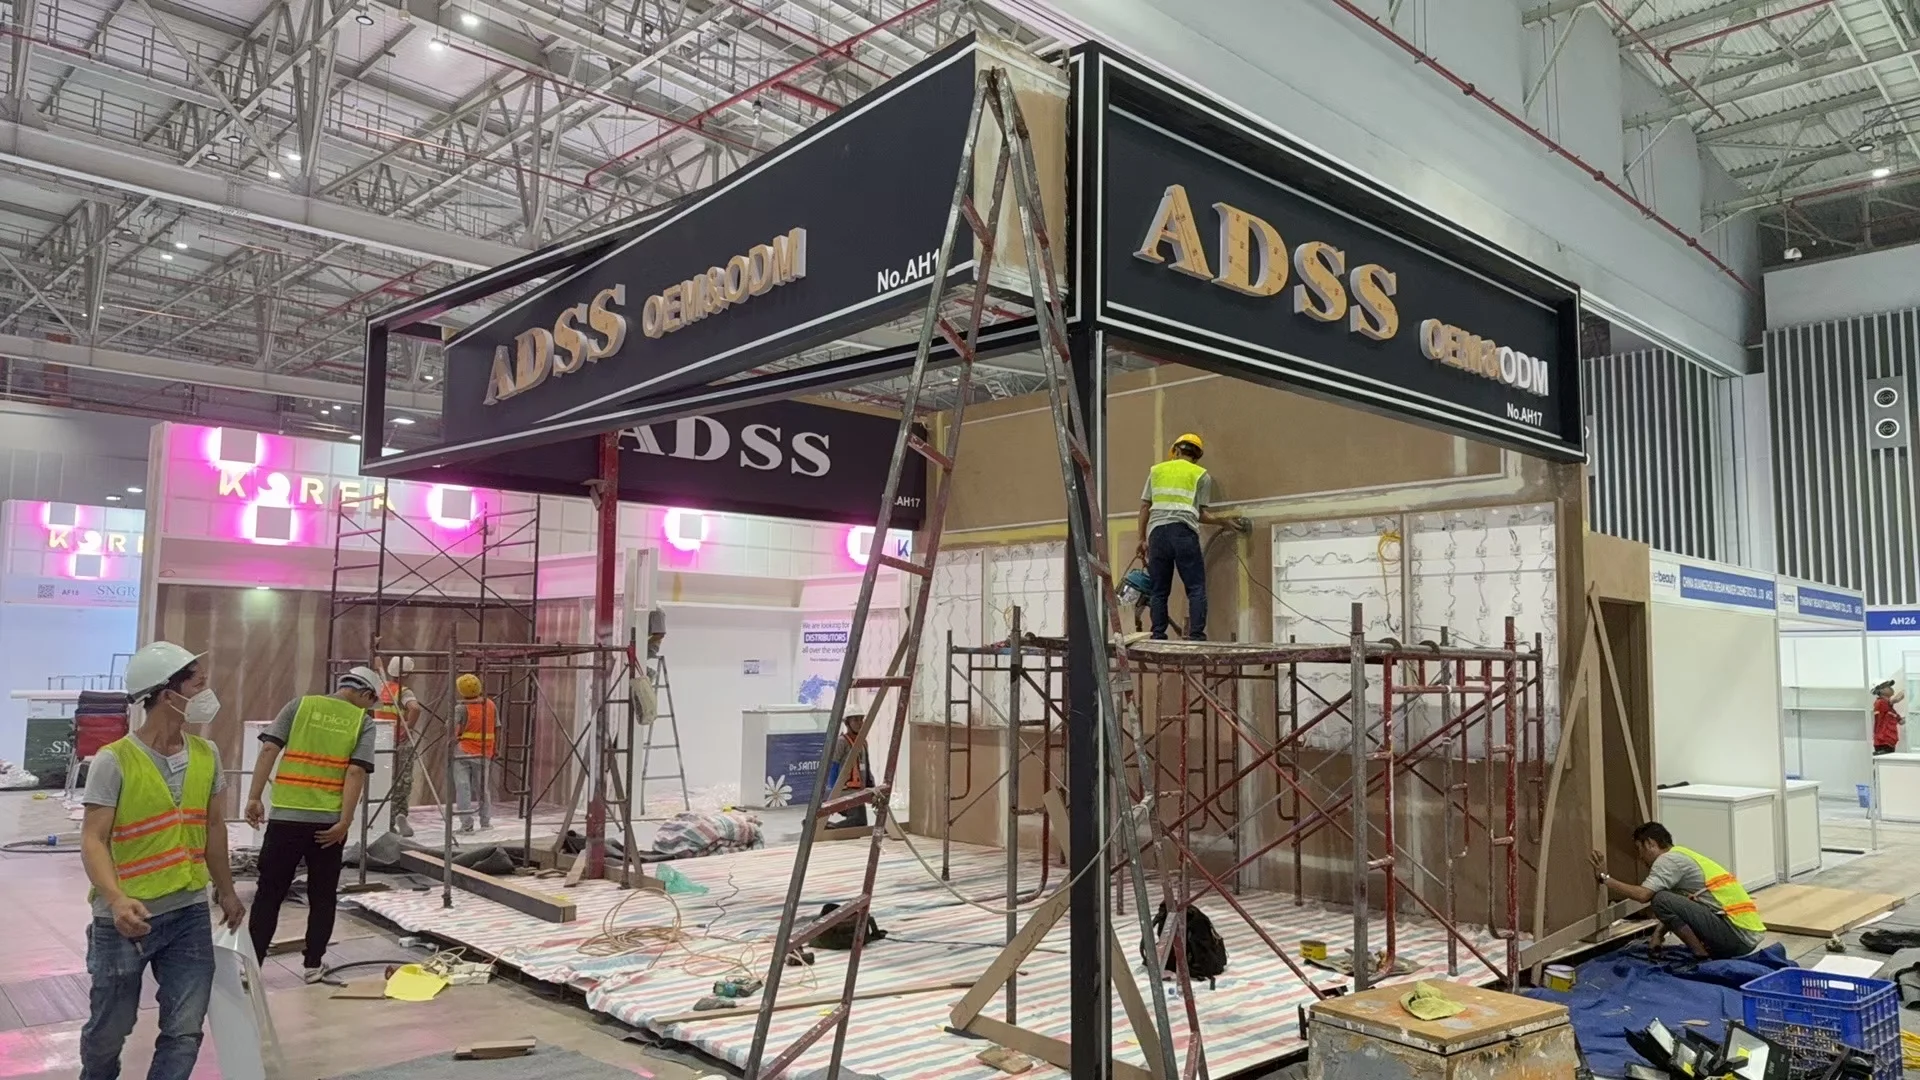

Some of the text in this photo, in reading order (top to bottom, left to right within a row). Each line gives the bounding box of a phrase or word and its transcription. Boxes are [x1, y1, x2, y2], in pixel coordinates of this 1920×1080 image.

[877, 248, 940, 293] No.AH1
[1132, 184, 1549, 396] ADSS OEM&ODM
[483, 227, 807, 405] ADSS OEM&ODM
[1507, 402, 1543, 428] No.AH17
[805, 633, 847, 642] DISTRIBUTORS
[1890, 617, 1916, 625] AH26
